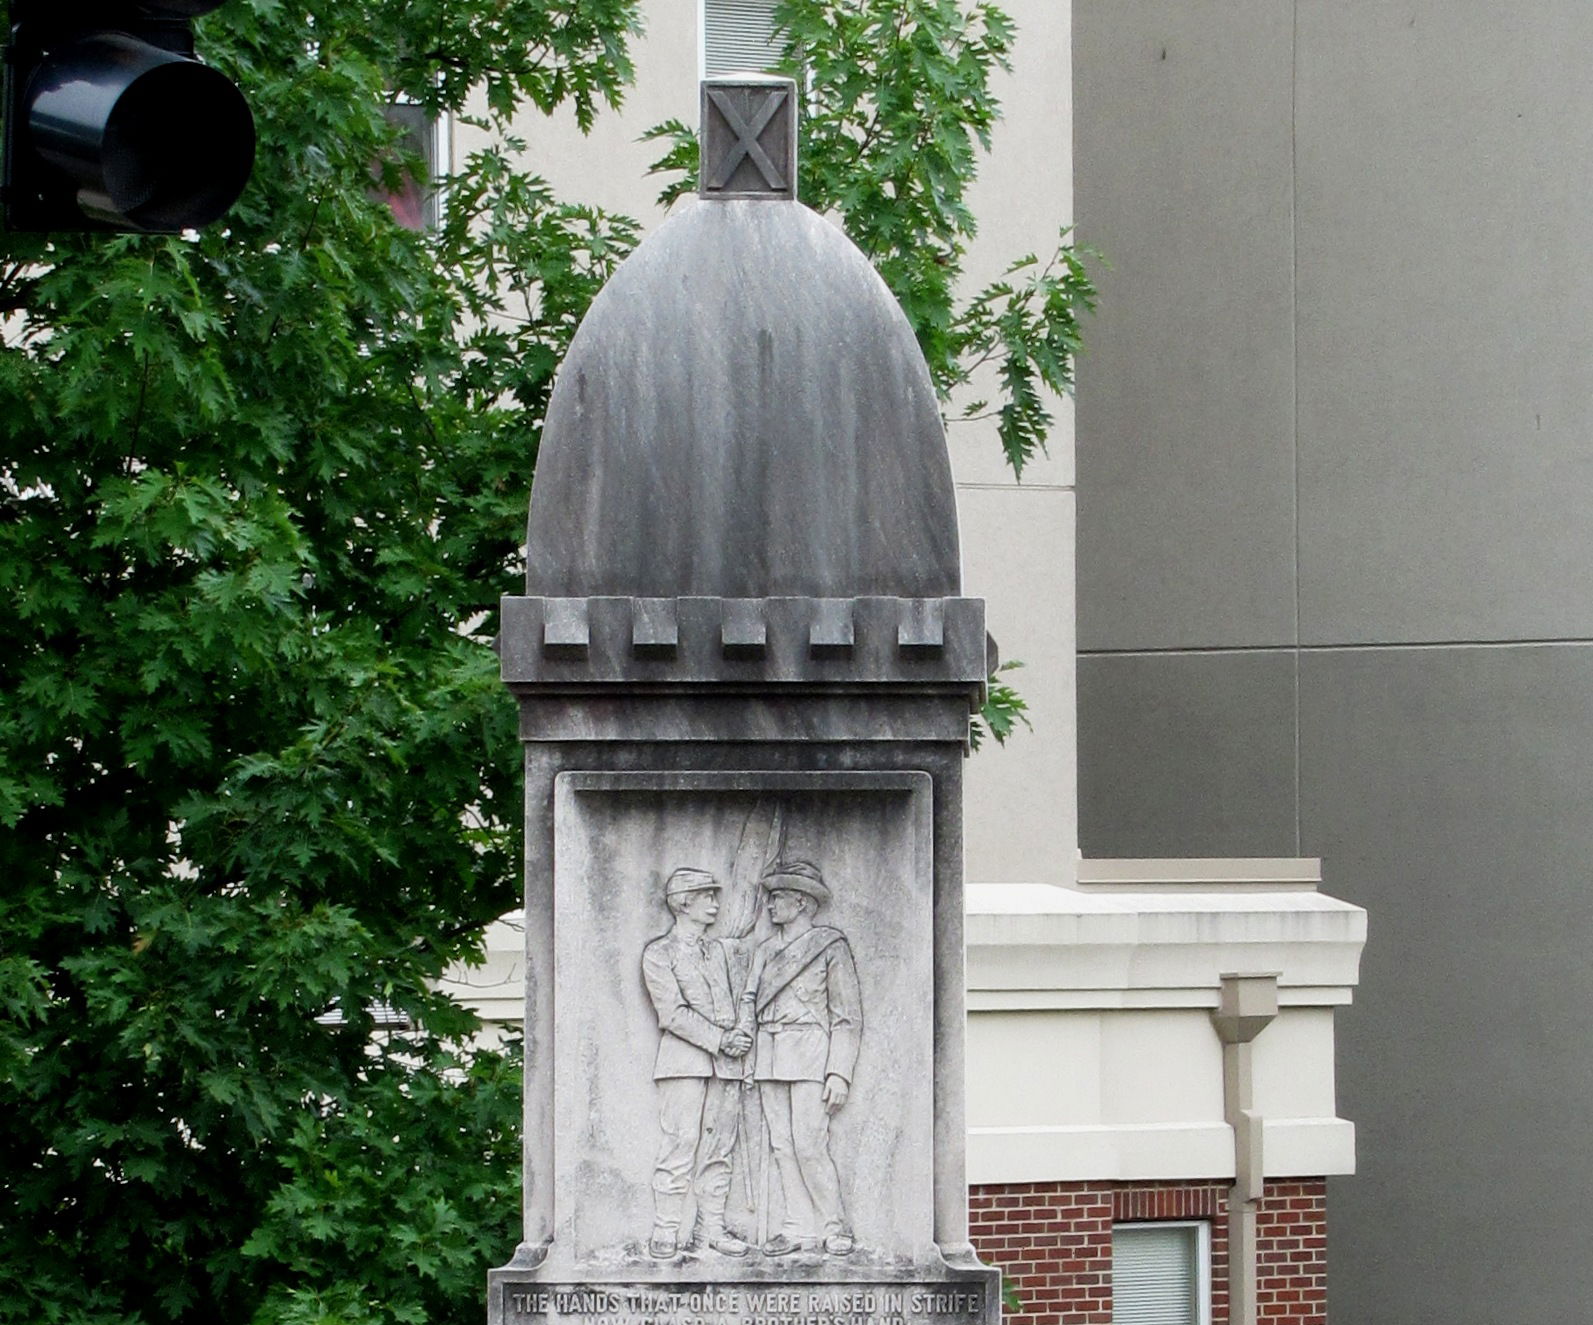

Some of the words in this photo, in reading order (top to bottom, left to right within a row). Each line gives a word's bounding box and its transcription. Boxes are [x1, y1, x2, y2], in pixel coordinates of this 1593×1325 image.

[512, 1293, 549, 1314] THE
[556, 1293, 620, 1314] HANDS
[690, 1293, 739, 1314] ONCE
[749, 1293, 800, 1314] WERE
[808, 1293, 876, 1314] RAISED
[884, 1293, 902, 1314] IN
[911, 1293, 979, 1314] STRIFE
